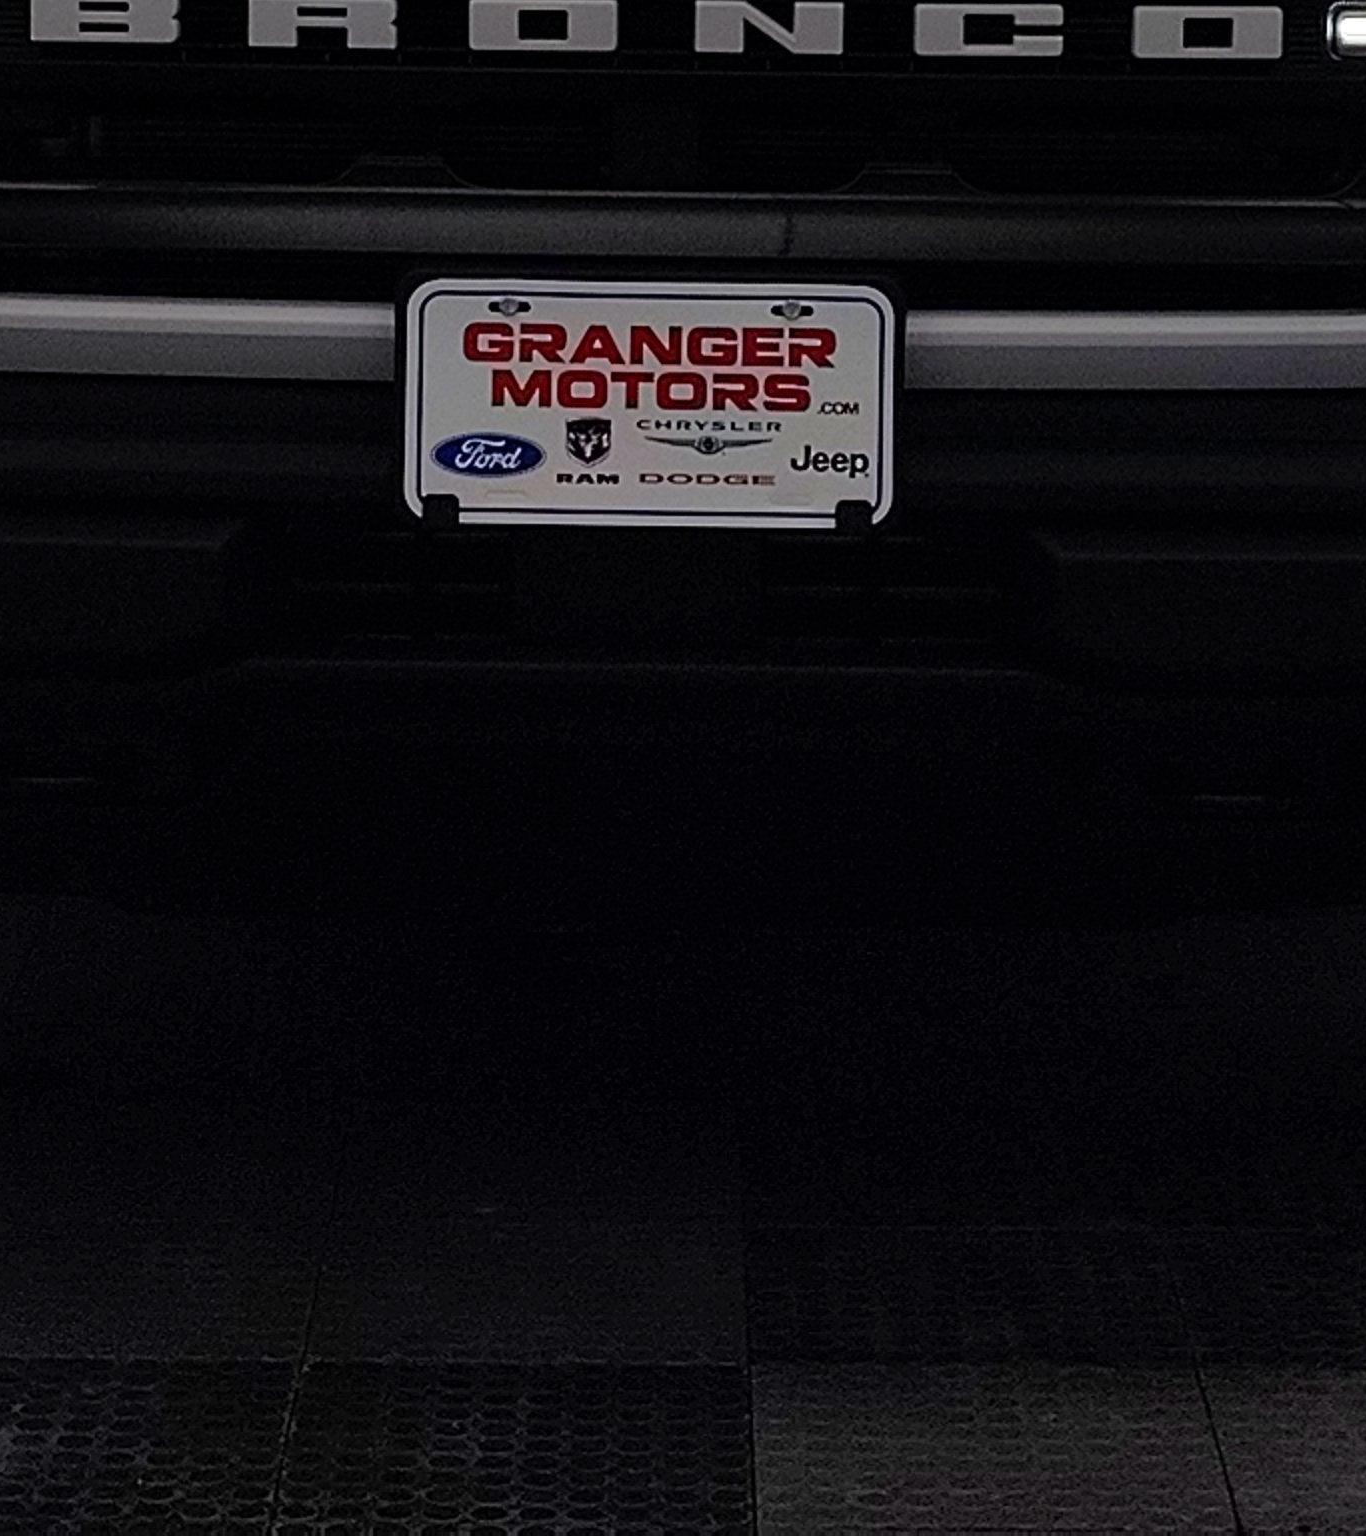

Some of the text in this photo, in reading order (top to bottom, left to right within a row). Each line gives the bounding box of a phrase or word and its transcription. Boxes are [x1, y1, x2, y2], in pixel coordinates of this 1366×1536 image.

[463, 322, 837, 368] GRANGER
[491, 369, 859, 415] MOTORS .COM
[636, 419, 782, 432] CHRYSLER
[455, 437, 522, 469] Ford
[790, 445, 869, 478] Jeep
[556, 473, 620, 485] RAM
[639, 473, 776, 486] DODGE
